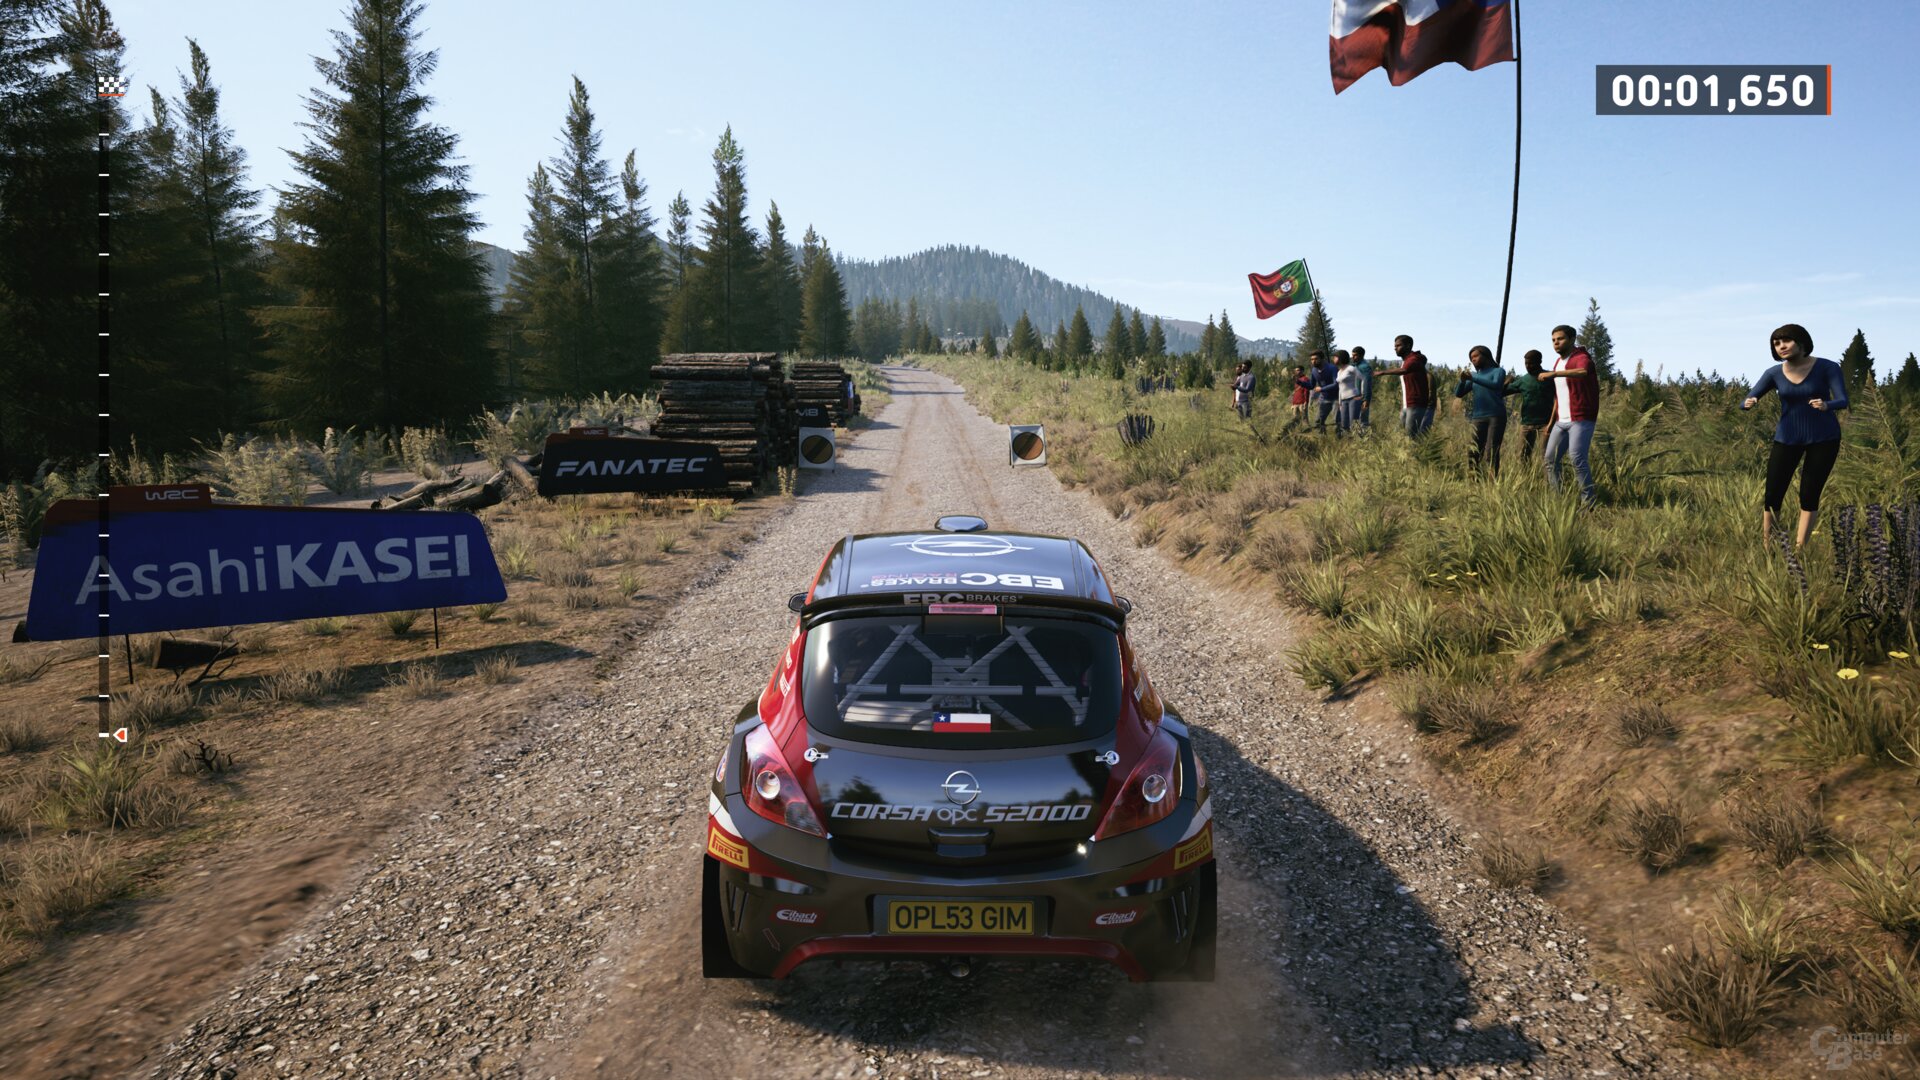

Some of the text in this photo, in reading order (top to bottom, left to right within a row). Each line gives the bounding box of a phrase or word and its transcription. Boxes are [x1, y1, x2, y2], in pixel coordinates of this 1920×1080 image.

[555, 457, 708, 477] FANATEC
[145, 488, 199, 501] WRC
[960, 572, 1065, 590] EBC
[903, 593, 964, 604] EBC
[830, 802, 934, 822] CORSA
[983, 804, 1092, 823] S2000
[711, 833, 744, 863] PIRELLI
[1183, 834, 1210, 863] PIRELLI
[895, 905, 1027, 930] OPL53 GIM
